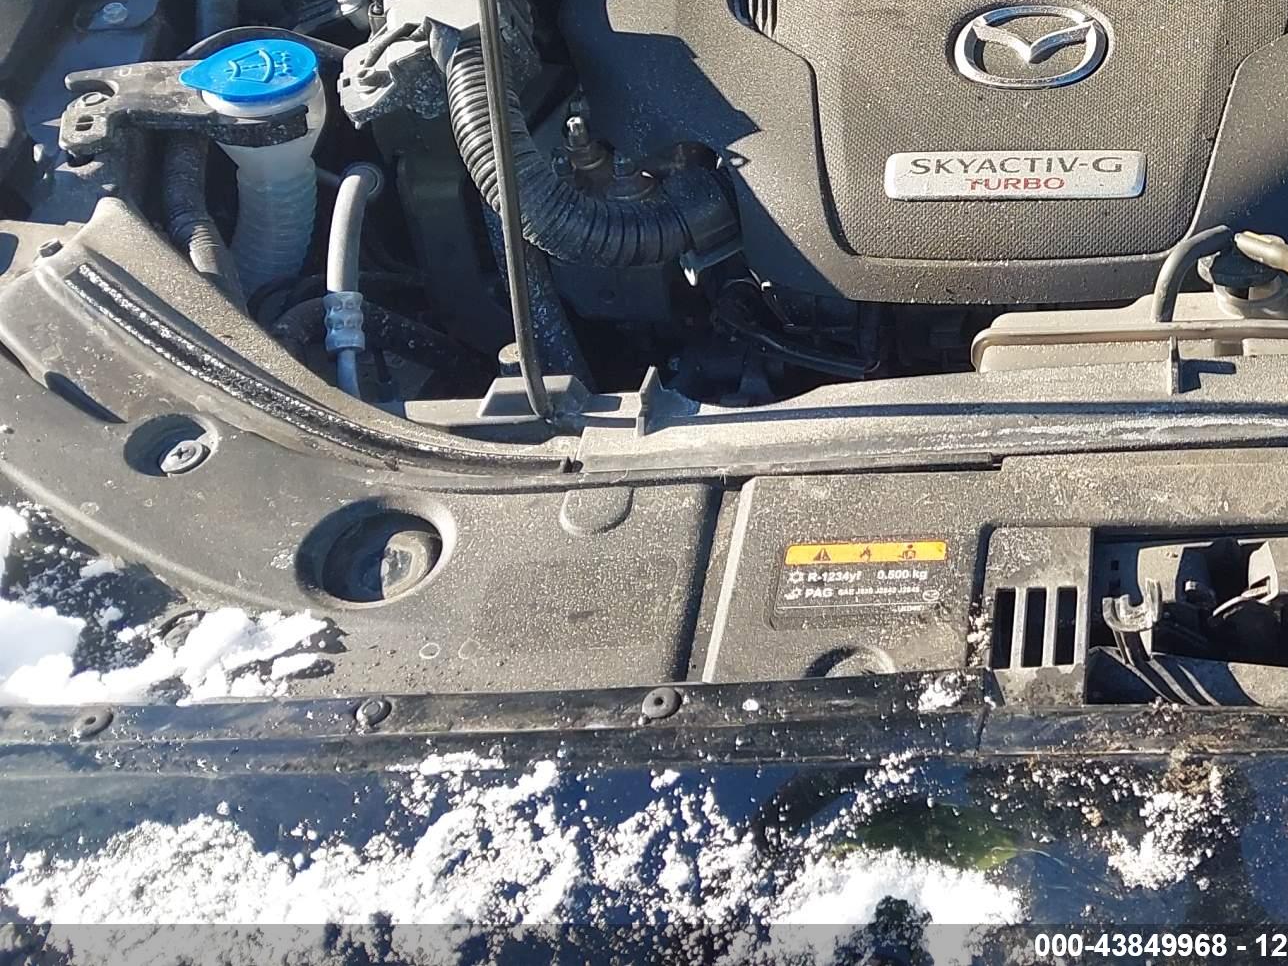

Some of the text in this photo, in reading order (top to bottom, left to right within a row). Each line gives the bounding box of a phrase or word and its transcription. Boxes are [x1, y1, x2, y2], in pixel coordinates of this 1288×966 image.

[910, 156, 1123, 175] SKYACTIV-G
[965, 177, 1066, 191] TURBO
[807, 569, 928, 583] R-1234yf 0.500 kg
[804, 587, 833, 599] PAG
